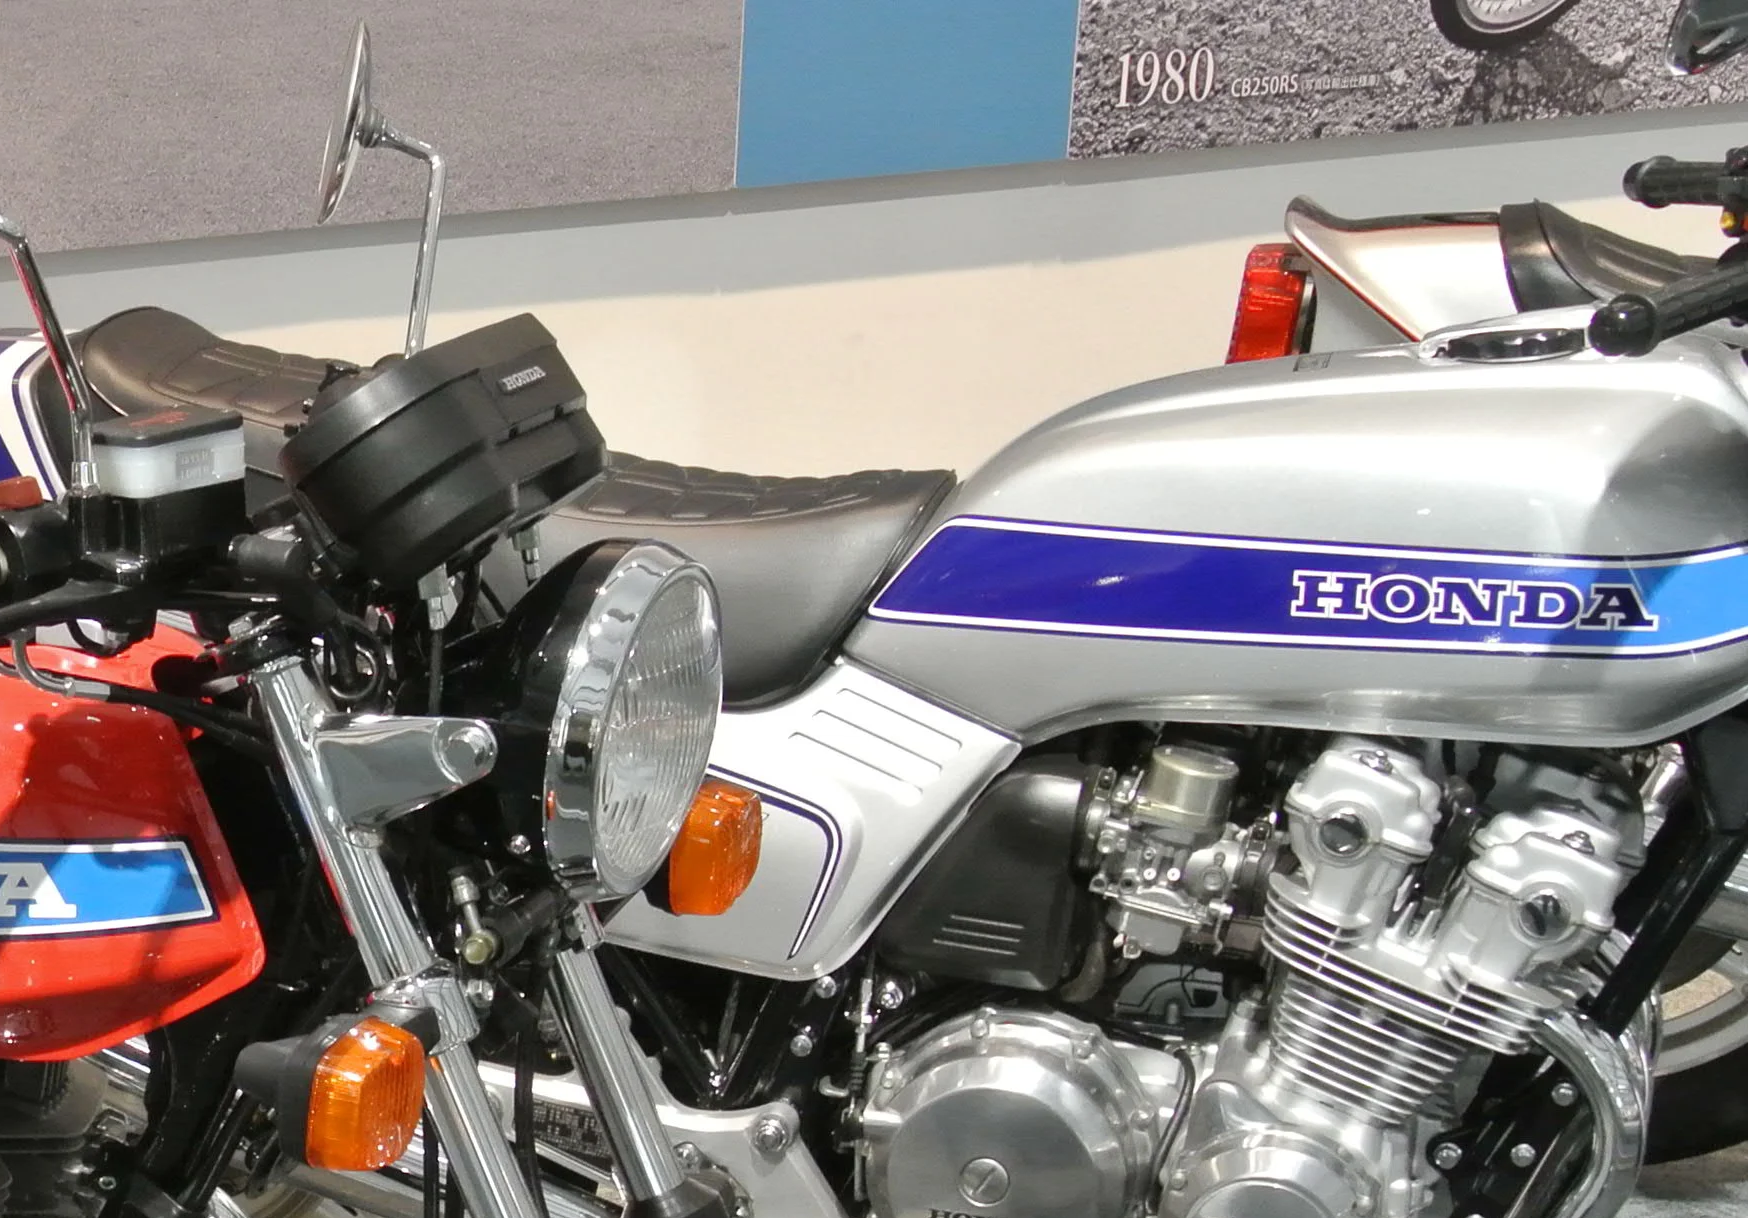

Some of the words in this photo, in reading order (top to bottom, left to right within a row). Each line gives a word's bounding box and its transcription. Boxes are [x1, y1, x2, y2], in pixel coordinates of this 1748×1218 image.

[1117, 47, 1215, 109] 1980
[1230, 73, 1299, 98] CB250RS
[502, 365, 546, 391] HONDA
[1290, 569, 1660, 632] HONDA
